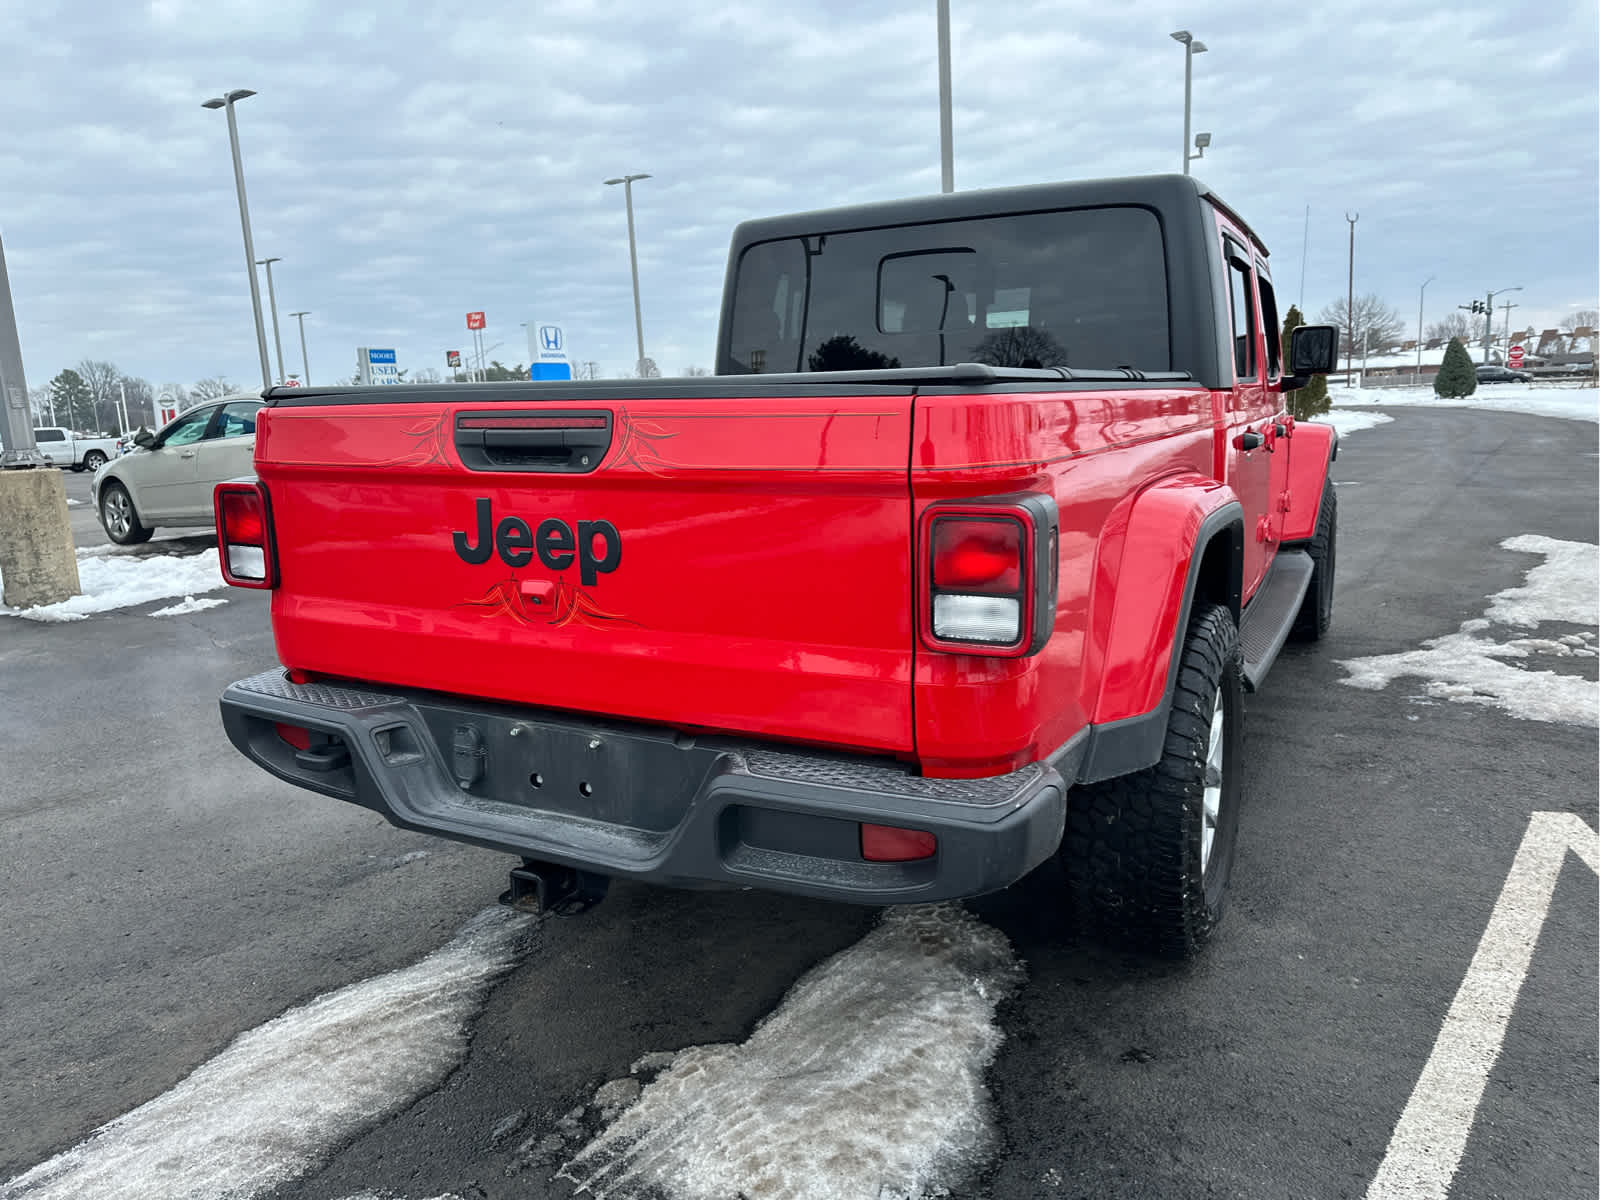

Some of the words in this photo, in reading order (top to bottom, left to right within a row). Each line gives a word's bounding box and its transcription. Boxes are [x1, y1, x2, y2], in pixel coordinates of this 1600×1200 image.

[370, 352, 394, 360] MOORE
[371, 366, 398, 376] USED
[452, 497, 622, 586] Jeep
